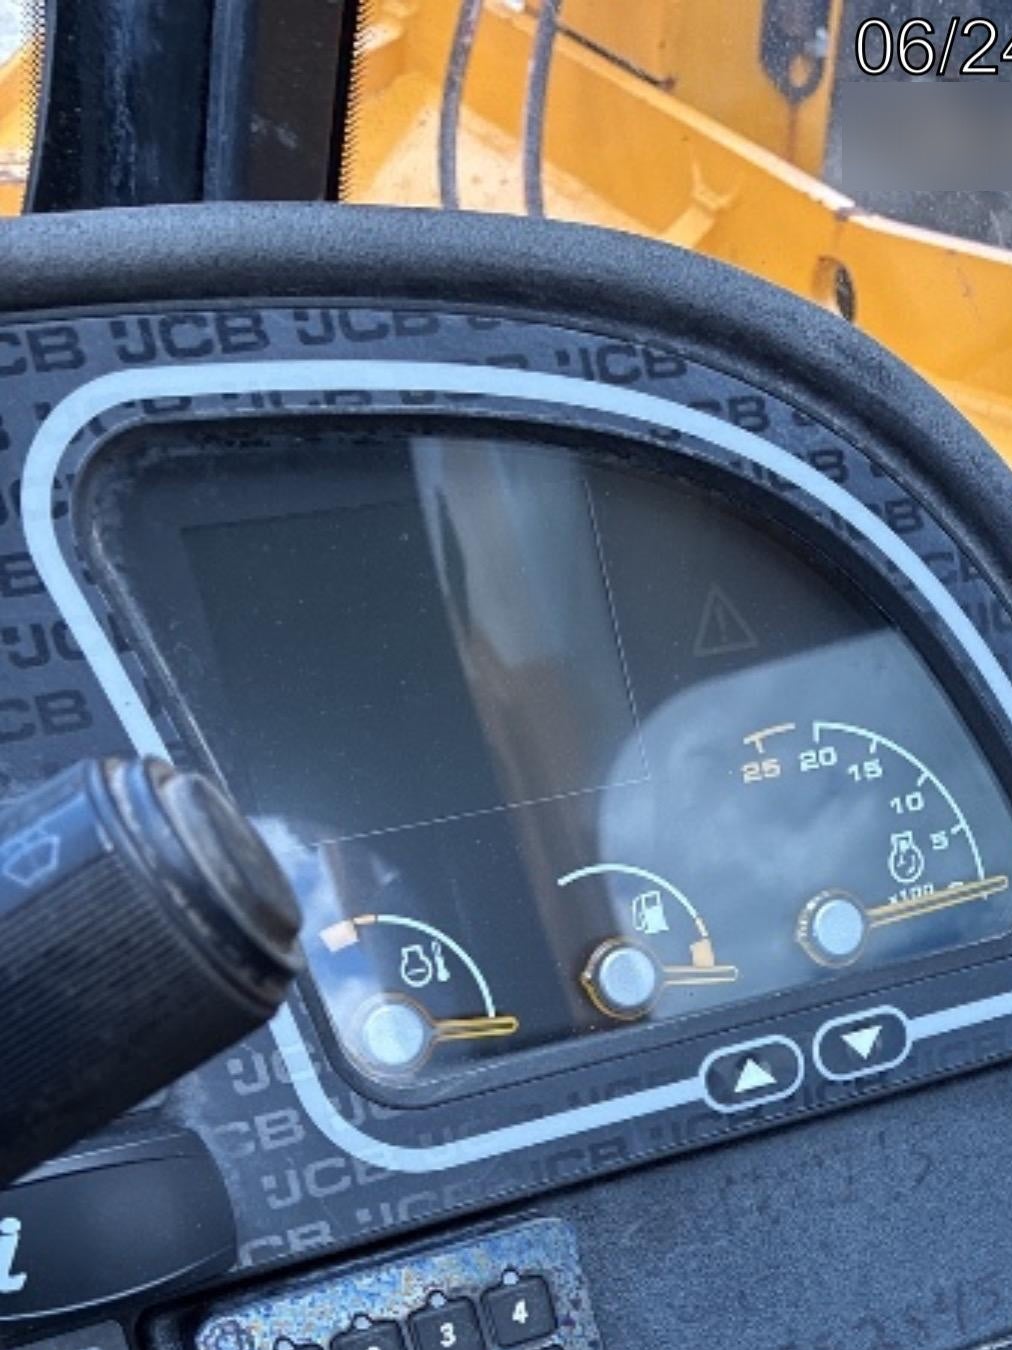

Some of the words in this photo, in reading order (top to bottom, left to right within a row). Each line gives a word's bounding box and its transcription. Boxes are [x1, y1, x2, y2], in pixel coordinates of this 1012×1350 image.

[0, 326, 85, 376] CB
[110, 312, 271, 364] JCB
[0, 689, 93, 743] CB
[741, 759, 781, 783] 25
[800, 746, 838, 772] 20
[848, 759, 883, 781] 15
[889, 791, 925, 814] 10
[929, 831, 950, 850] 5
[211, 1108, 305, 1158] CB
[511, 1299, 529, 1324] 4
[440, 1323, 457, 1348] 3
